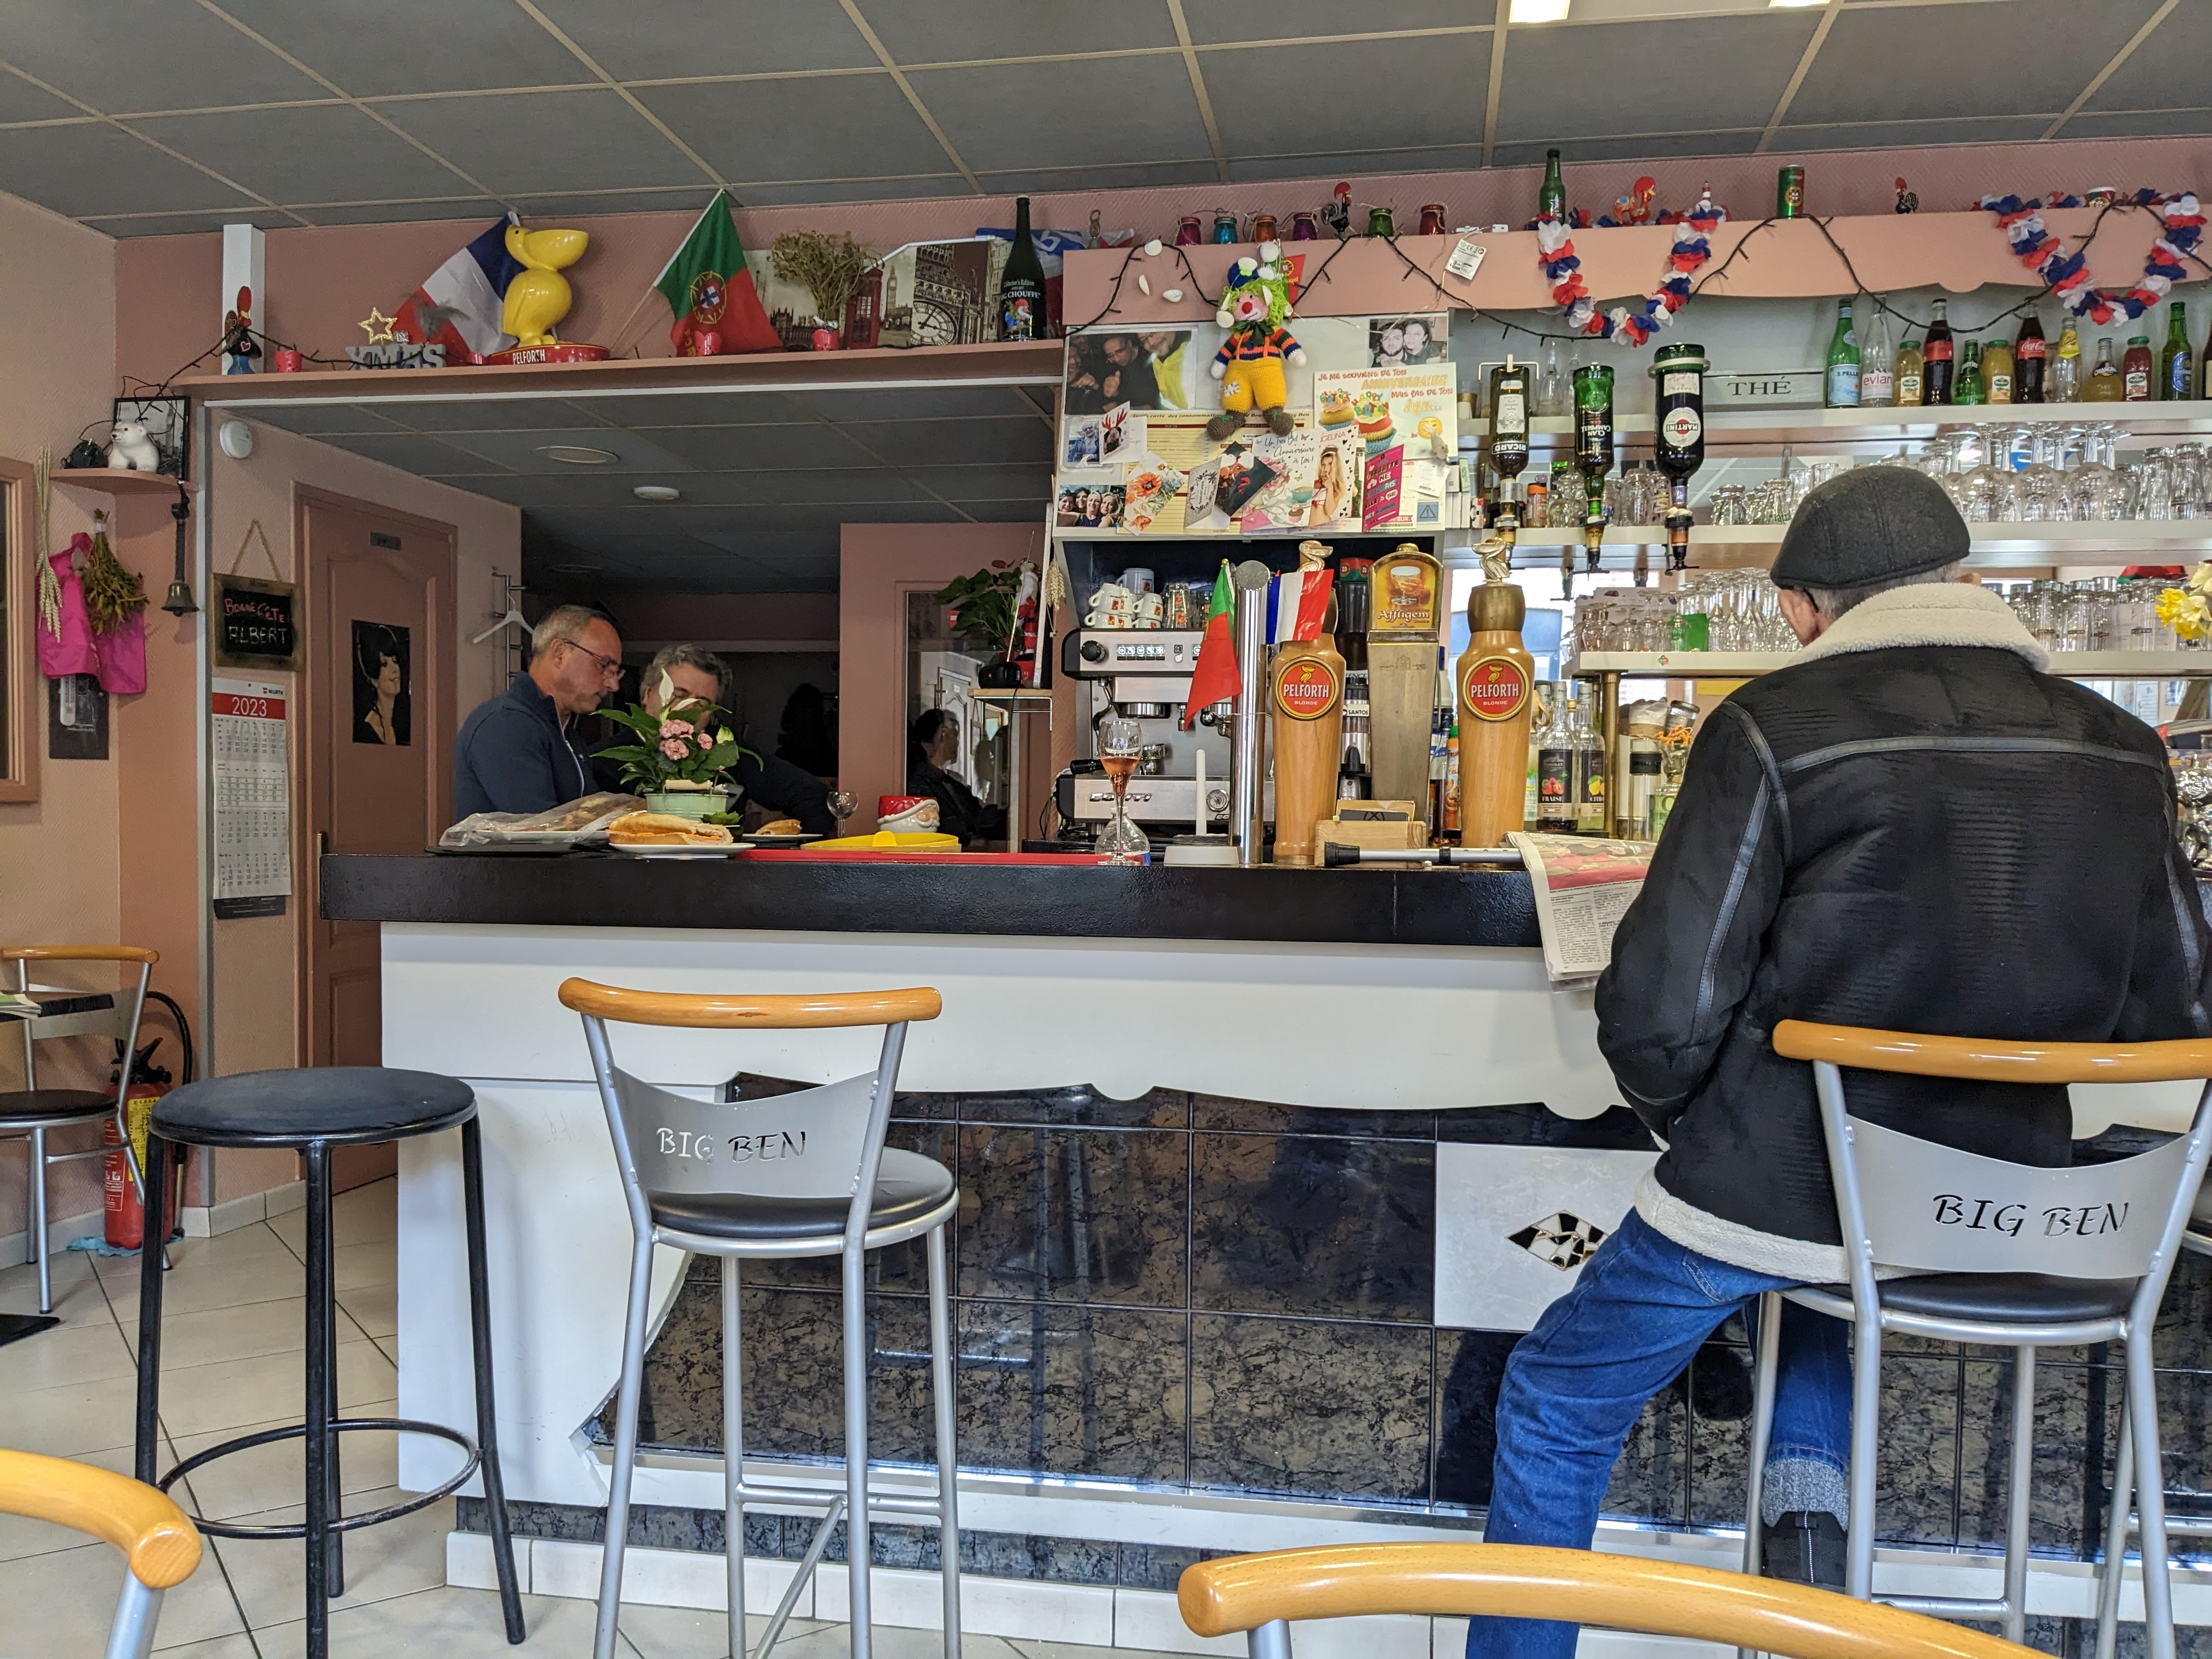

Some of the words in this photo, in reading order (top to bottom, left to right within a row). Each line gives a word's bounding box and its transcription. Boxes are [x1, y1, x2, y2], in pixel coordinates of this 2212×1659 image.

[512, 349, 545, 365] PELFORTH
[1727, 376, 1791, 396] THÉ
[1863, 375, 1892, 386] evian
[1667, 424, 1698, 432] MARTINI
[1265, 437, 1274, 447] Un
[1494, 442, 1527, 452] RICARD
[1273, 446, 1315, 458] Anniversaire
[1379, 472, 1390, 481] NE
[1379, 502, 1396, 512] JOUR
[1378, 610, 1429, 623] Affligem
[229, 626, 287, 644] ALBERT
[1283, 684, 1329, 698] PELFORTH
[1471, 684, 1519, 698] PELFORTH
[232, 697, 267, 717] 2023
[657, 1127, 714, 1165] BIG
[728, 1131, 806, 1163] BEN
[1933, 1194, 2027, 1238] BIG
[2042, 1201, 2129, 1238] BEN
